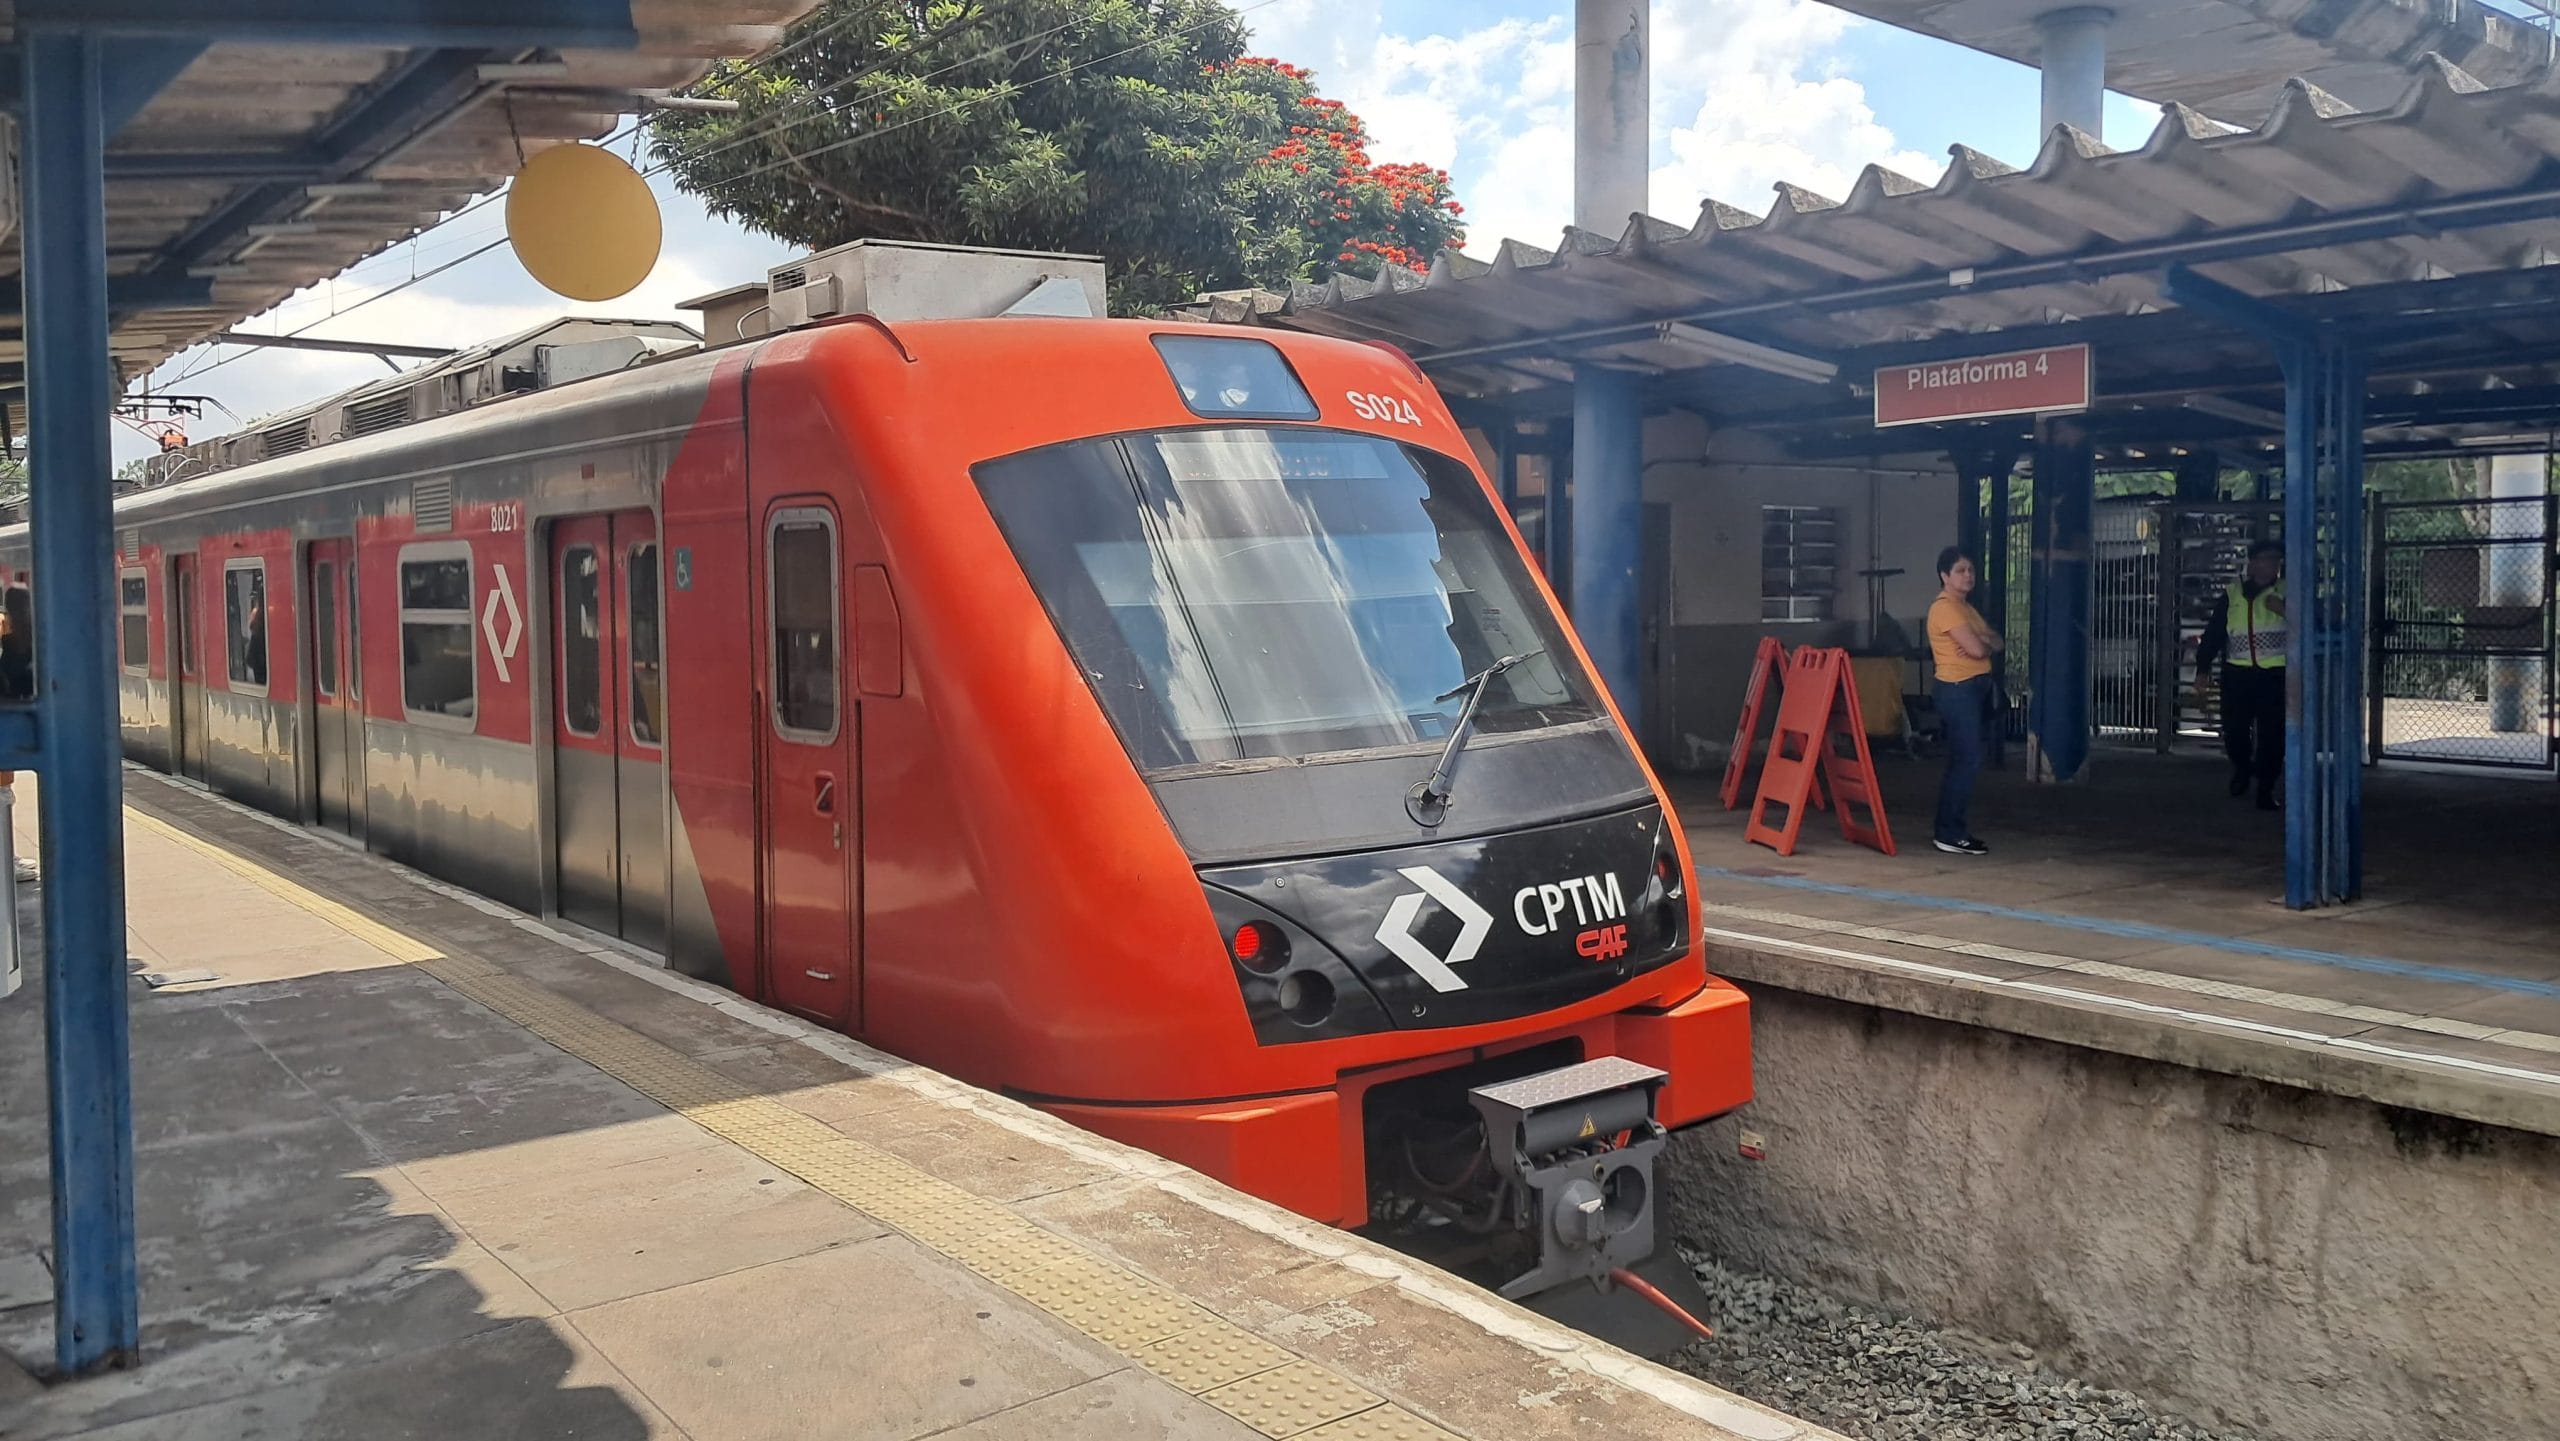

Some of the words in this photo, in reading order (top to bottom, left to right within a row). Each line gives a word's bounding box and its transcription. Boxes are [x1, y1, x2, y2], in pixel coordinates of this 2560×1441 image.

[1907, 358, 2028, 391] Plataforma
[2034, 353, 2049, 376] 4
[1346, 390, 1423, 427] S024
[490, 504, 517, 532] 8021
[1514, 872, 1626, 936] CPTM
[1575, 924, 1628, 961] CAF
